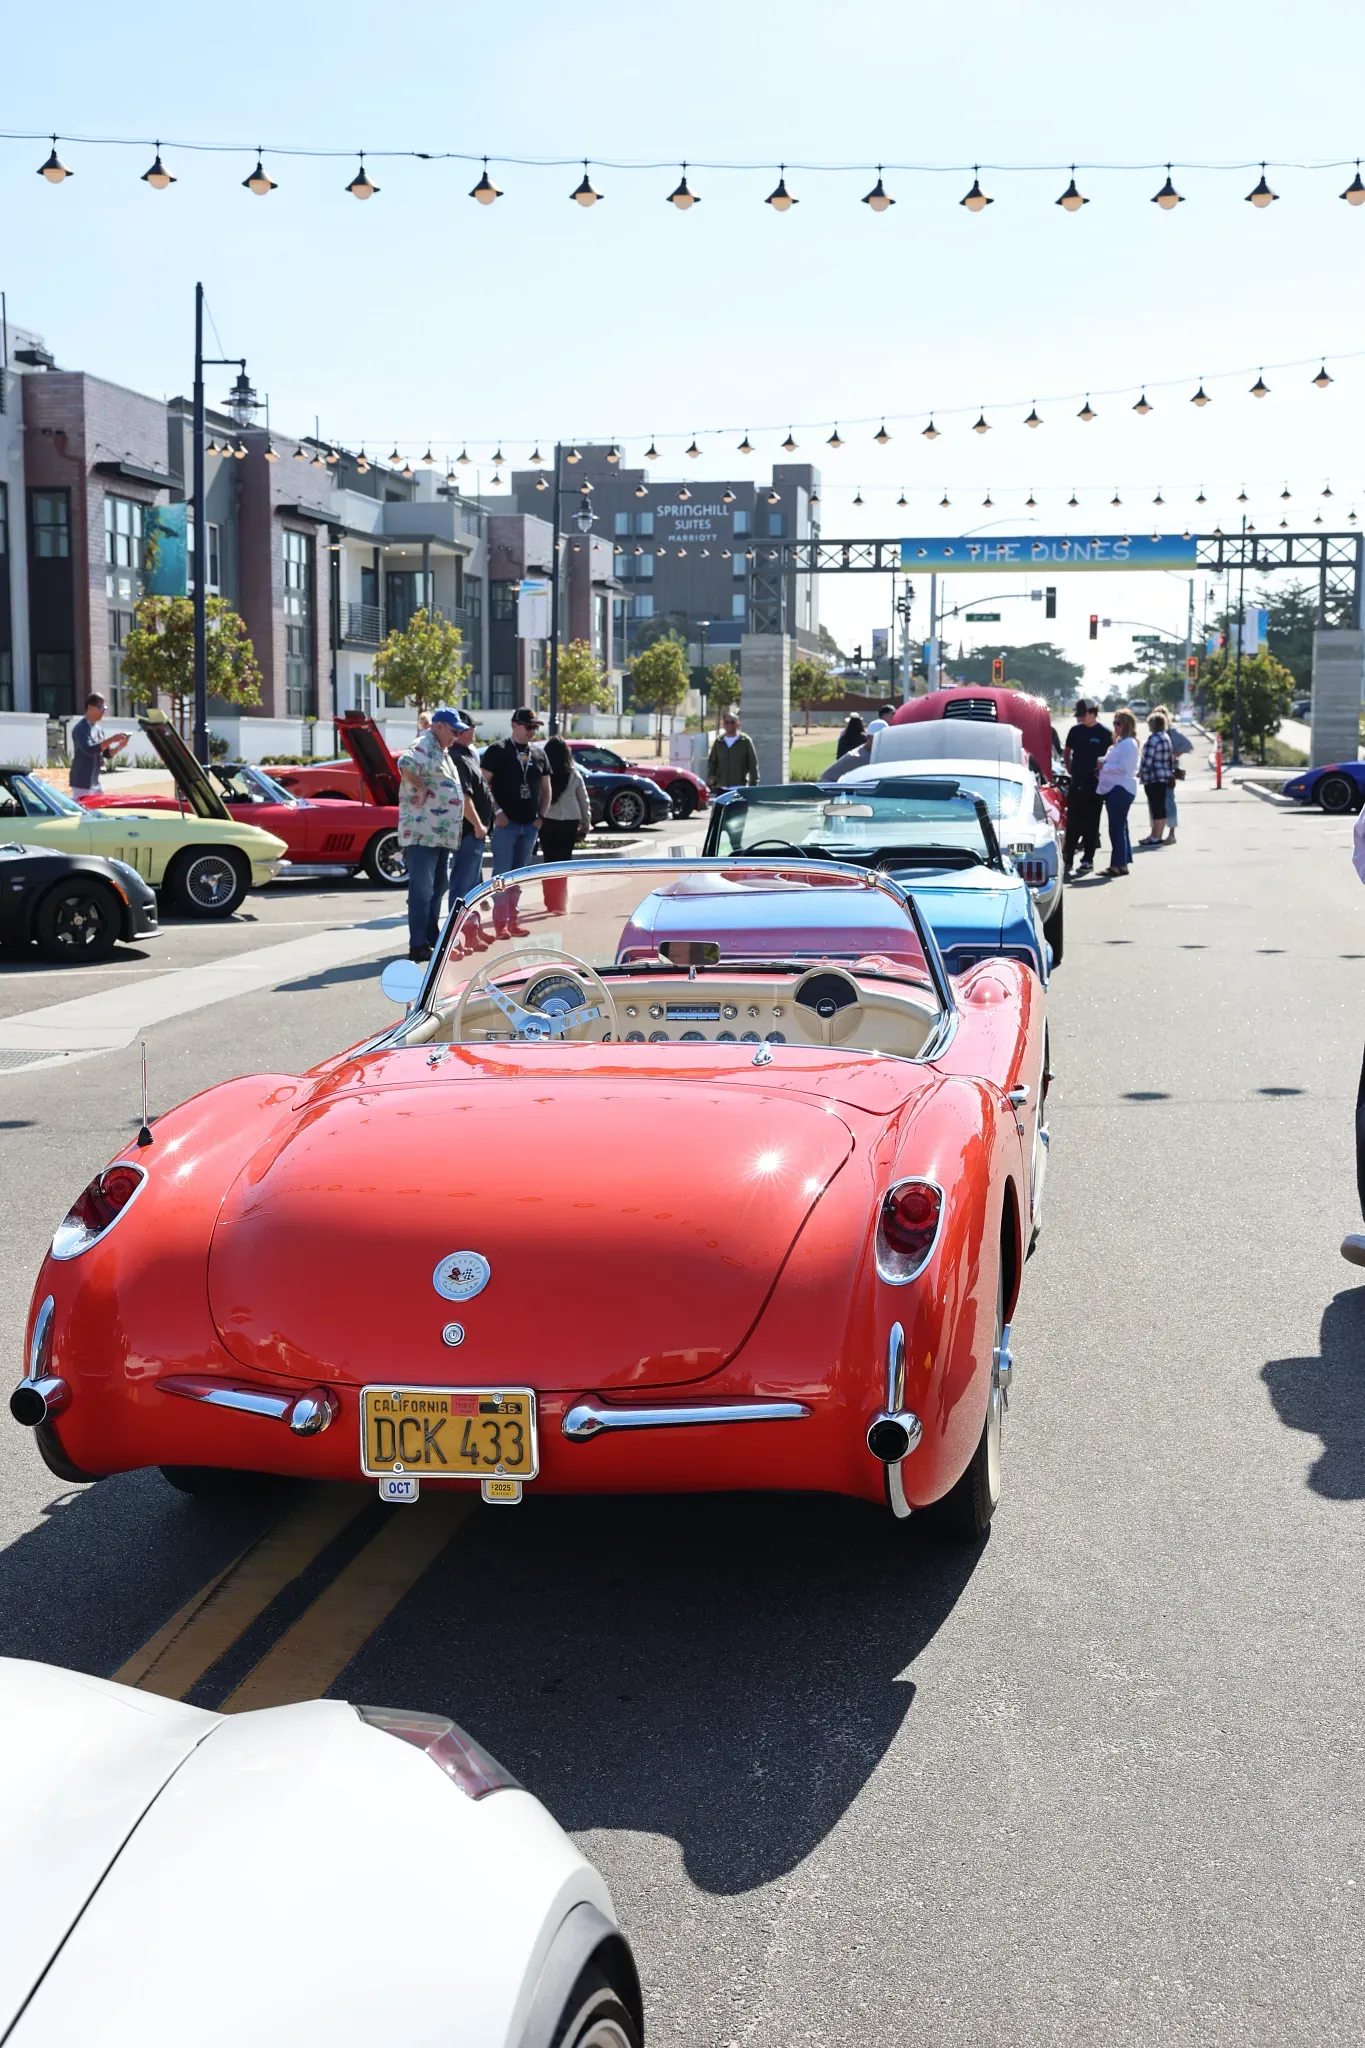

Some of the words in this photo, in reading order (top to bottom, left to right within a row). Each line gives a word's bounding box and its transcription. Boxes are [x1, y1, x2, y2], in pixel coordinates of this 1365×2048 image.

[656, 504, 729, 517] SPRINGHILL
[675, 519, 712, 530] SUITES
[668, 532, 718, 542] MARRIOTT
[965, 543, 1021, 562] THE
[1031, 541, 1130, 562] DUNES
[374, 1399, 448, 1413] CALIFORNIA
[374, 1417, 448, 1464] DCK
[460, 1419, 524, 1465] 433
[388, 1481, 411, 1494] OCT
[494, 1483, 511, 1491] 2025
